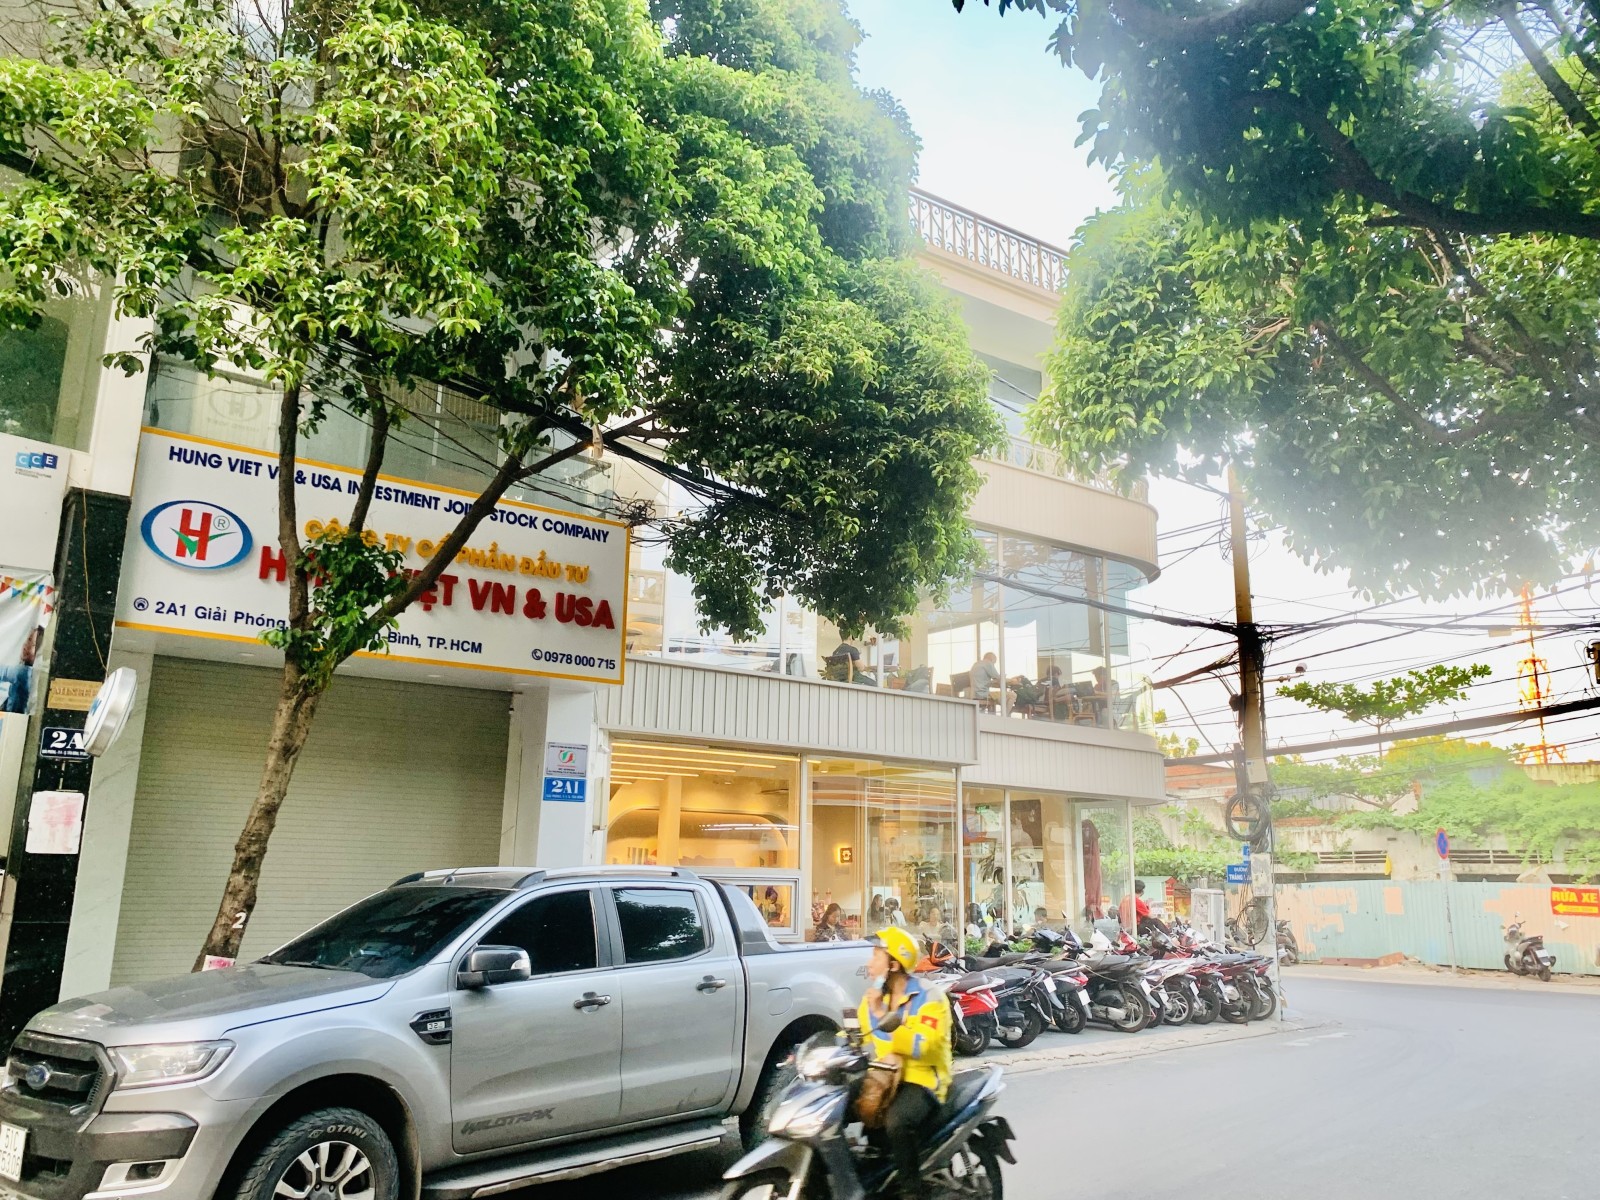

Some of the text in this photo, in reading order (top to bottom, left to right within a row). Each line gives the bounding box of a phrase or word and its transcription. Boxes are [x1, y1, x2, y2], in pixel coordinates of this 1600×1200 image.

[18, 455, 54, 466] CCE
[169, 445, 223, 469] HUNG
[227, 457, 263, 477] VIET
[294, 470, 307, 485] &
[311, 473, 342, 493] USA
[347, 480, 441, 511] INESTMENT
[490, 508, 539, 529] STOCK
[542, 518, 609, 543] COMPANY
[384, 533, 412, 553] TY
[155, 601, 187, 617] 2A1
[194, 606, 227, 622] Giải
[468, 578, 516, 615] VN
[523, 588, 547, 619] &
[555, 592, 615, 629] USA
[544, 651, 616, 670] 0978 000 715
[1581, 892, 1599, 903] XE
[232, 911, 247, 929] 2
[326, 1124, 367, 1139] OTANI
